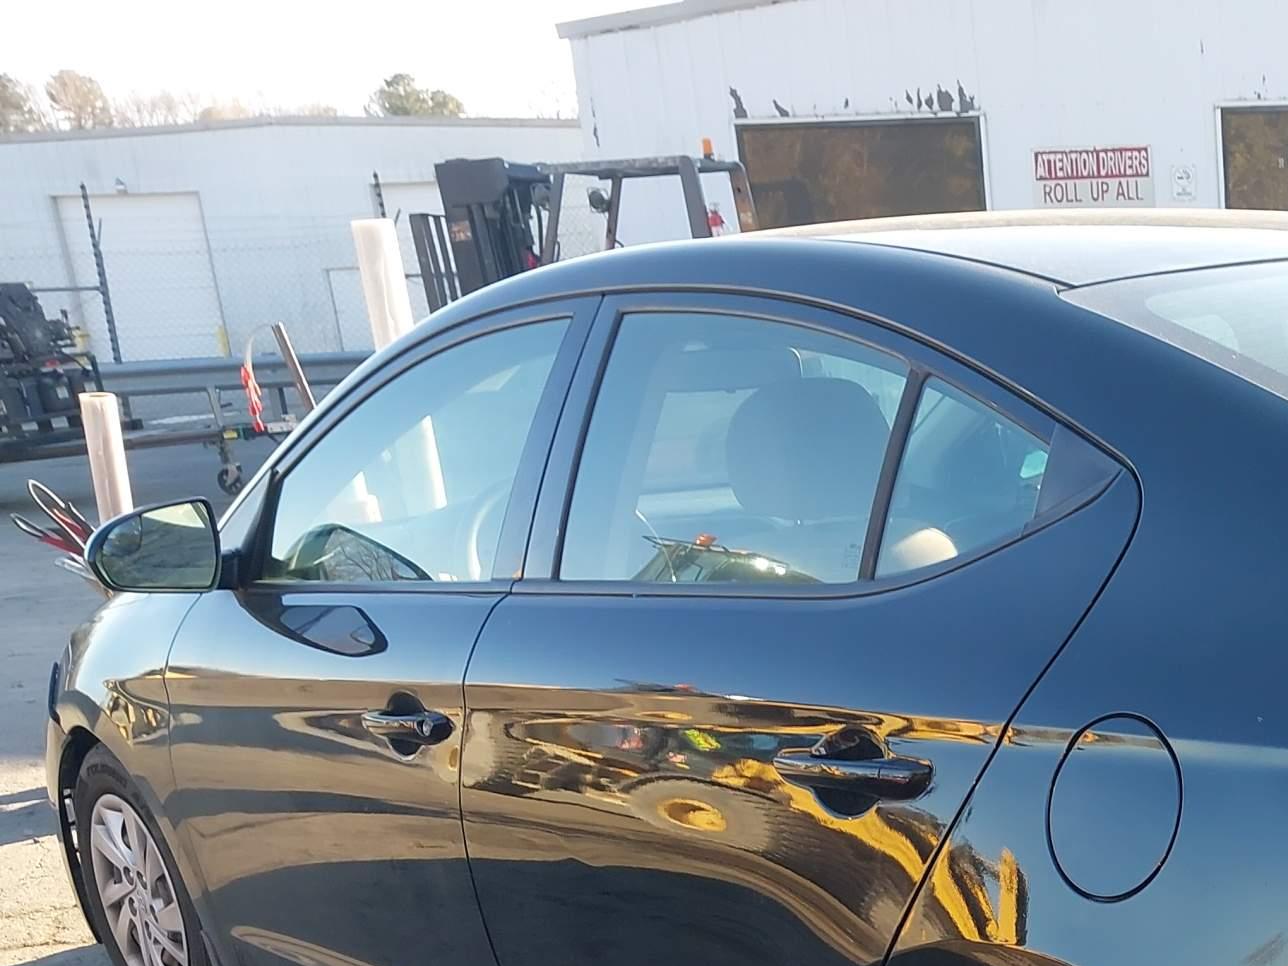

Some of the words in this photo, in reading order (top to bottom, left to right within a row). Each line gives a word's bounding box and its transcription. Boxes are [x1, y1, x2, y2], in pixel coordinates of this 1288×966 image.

[1037, 151, 1098, 178] ATTENTION
[1099, 150, 1148, 176] DRIVERS
[1043, 182, 1083, 204] ROLL
[1090, 180, 1110, 202] UP
[1115, 179, 1144, 201] ALL
